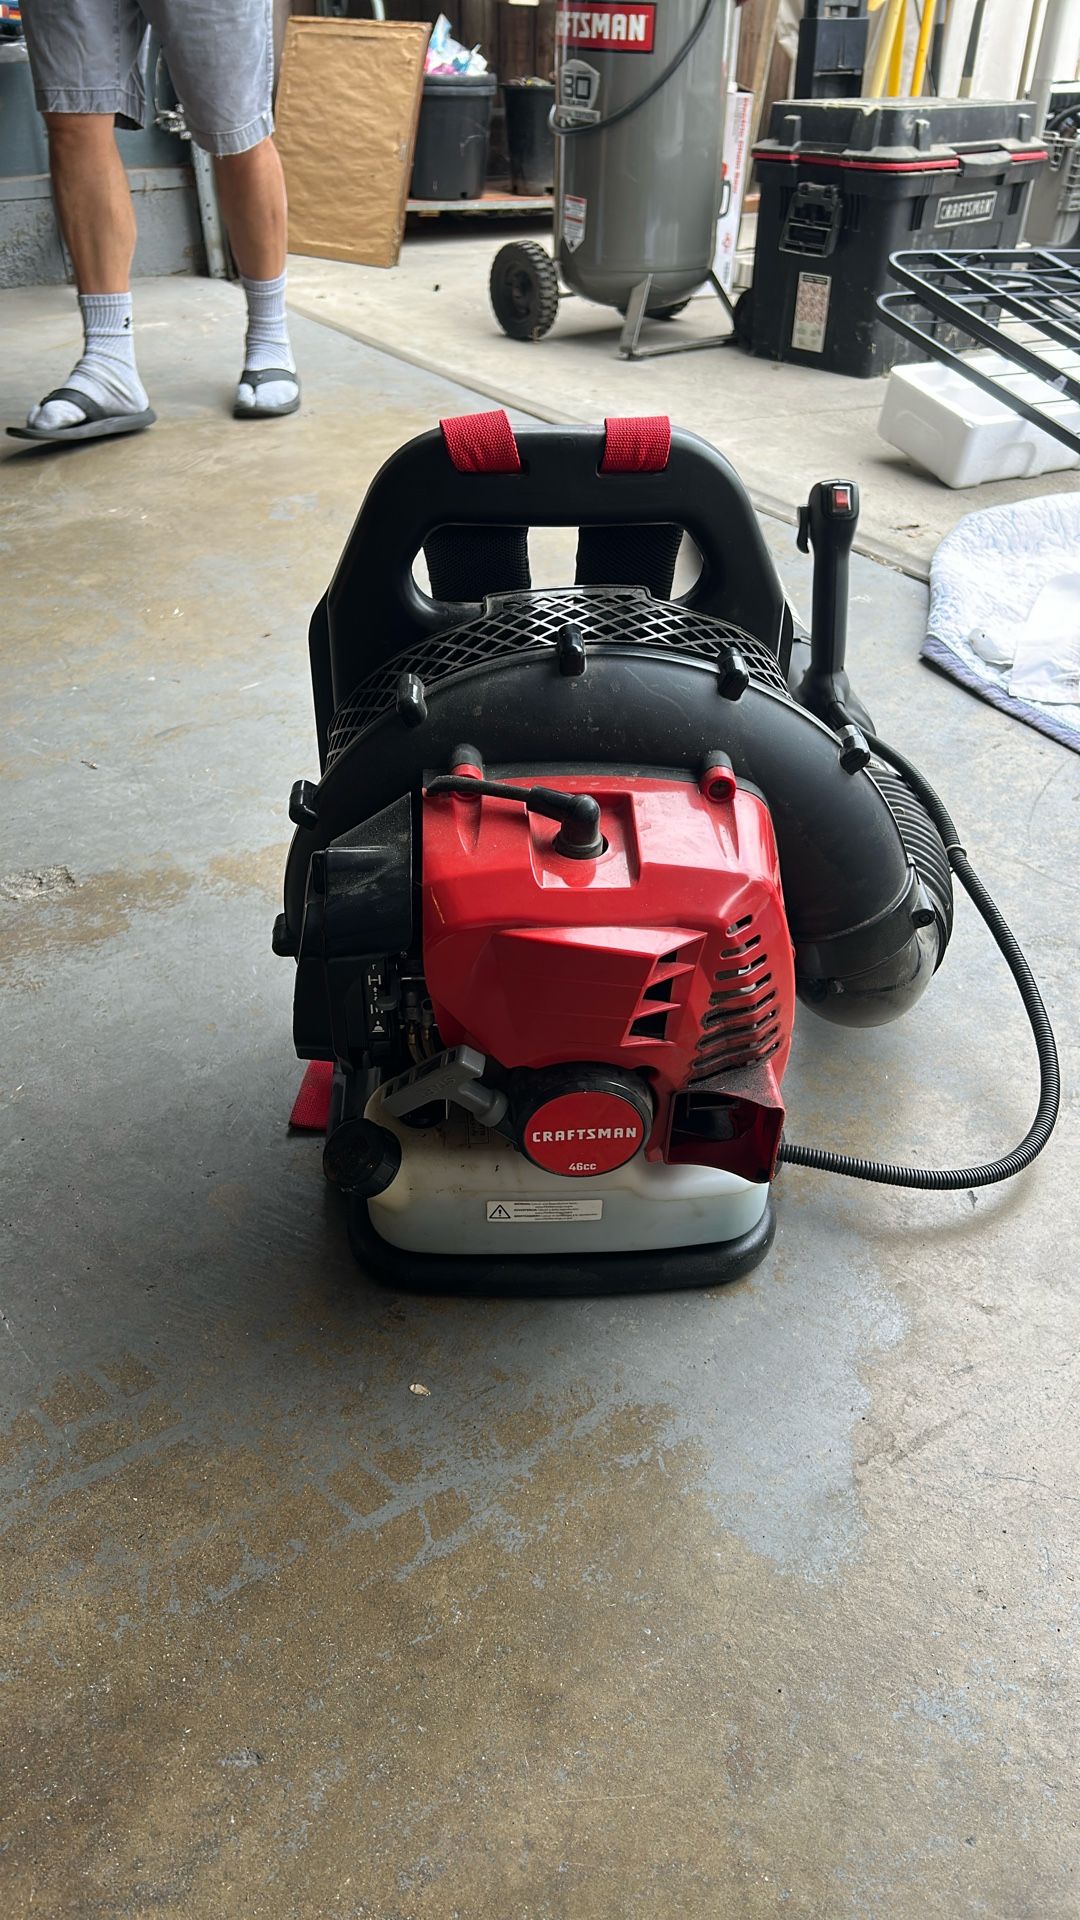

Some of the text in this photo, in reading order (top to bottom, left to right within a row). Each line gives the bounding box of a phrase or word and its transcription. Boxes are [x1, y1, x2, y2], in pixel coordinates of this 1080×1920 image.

[940, 199, 993, 220] CRAFTSMAN
[532, 1127, 637, 1143] CRAFTSMAN
[568, 1162, 597, 1172] 46cc
